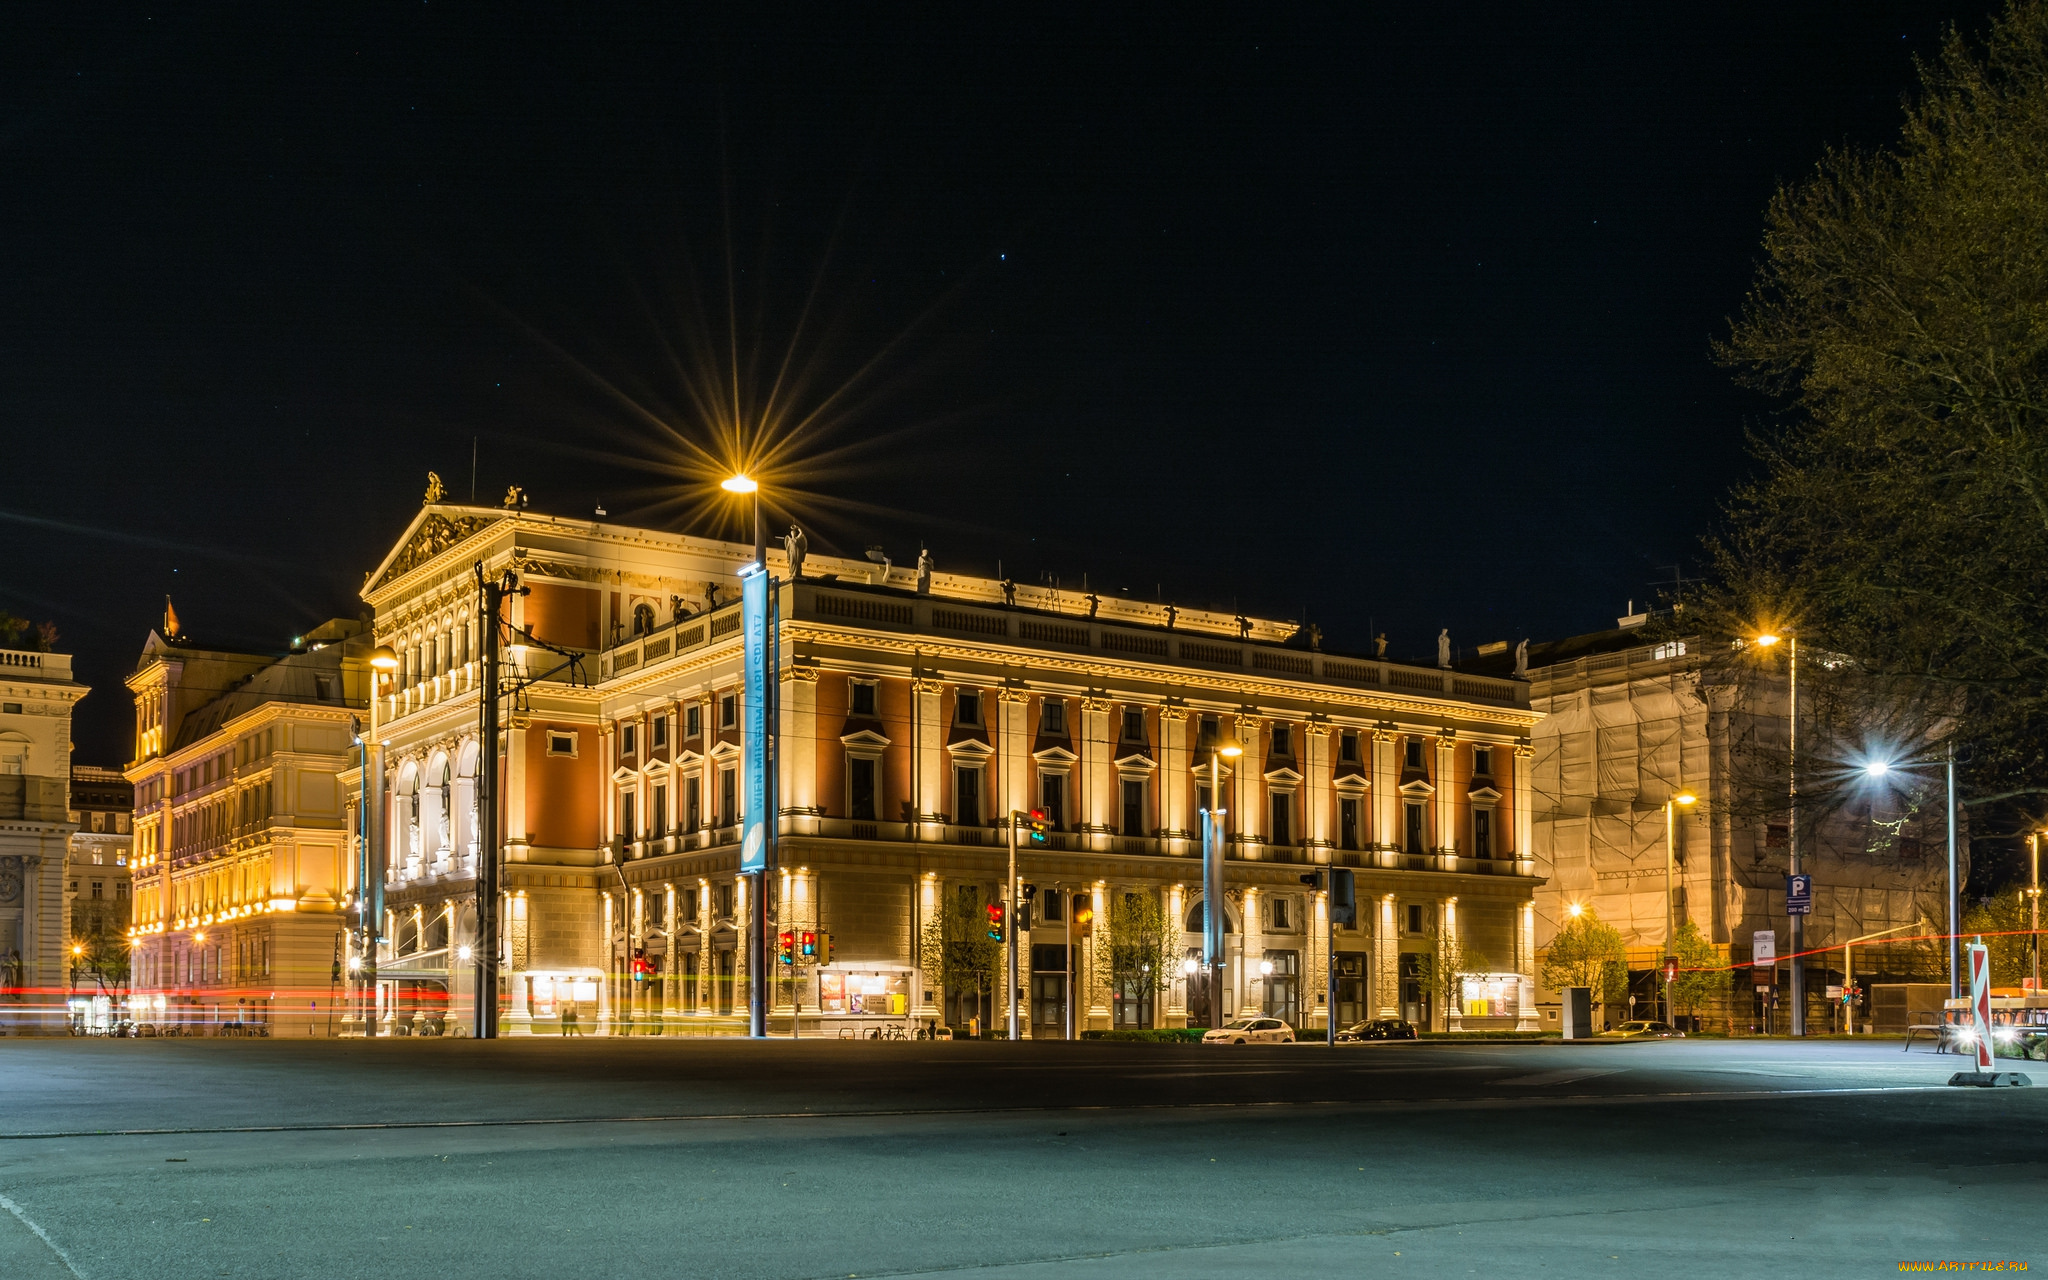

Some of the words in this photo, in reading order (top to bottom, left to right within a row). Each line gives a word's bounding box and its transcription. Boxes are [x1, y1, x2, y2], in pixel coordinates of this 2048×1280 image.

[431, 573, 443, 585] DER
[754, 774, 763, 811] WIEN
[1792, 880, 1804, 896] P
